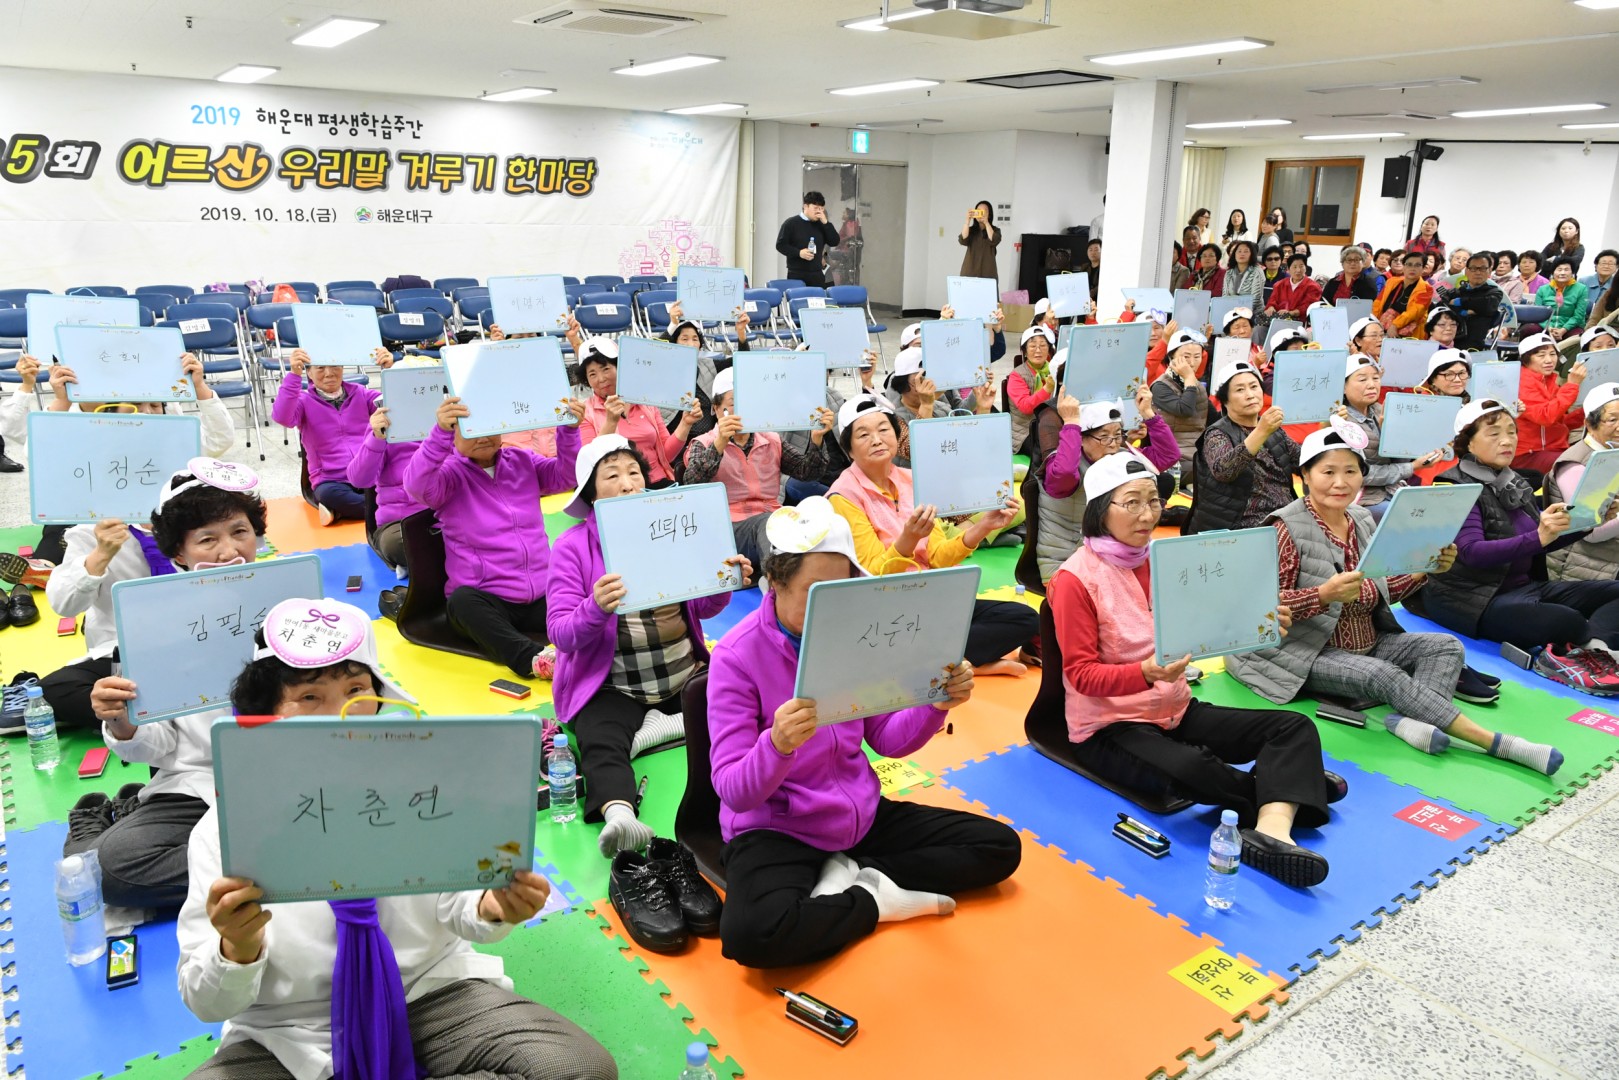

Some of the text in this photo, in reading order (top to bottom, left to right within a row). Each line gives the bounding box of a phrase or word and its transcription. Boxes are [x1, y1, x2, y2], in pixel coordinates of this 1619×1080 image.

[190, 104, 425, 140] 2019 해운대 평생학습주간
[279, 148, 391, 190] 우리말
[400, 153, 497, 192] 겨루기
[505, 156, 597, 196] 한마당
[199, 207, 248, 222] 2019.
[254, 208, 279, 222] 10.
[376, 208, 434, 224] 해운대구
[73, 455, 161, 492] 이정순
[292, 784, 453, 833] 차춘연
[1186, 957, 1234, 986] 여성회
